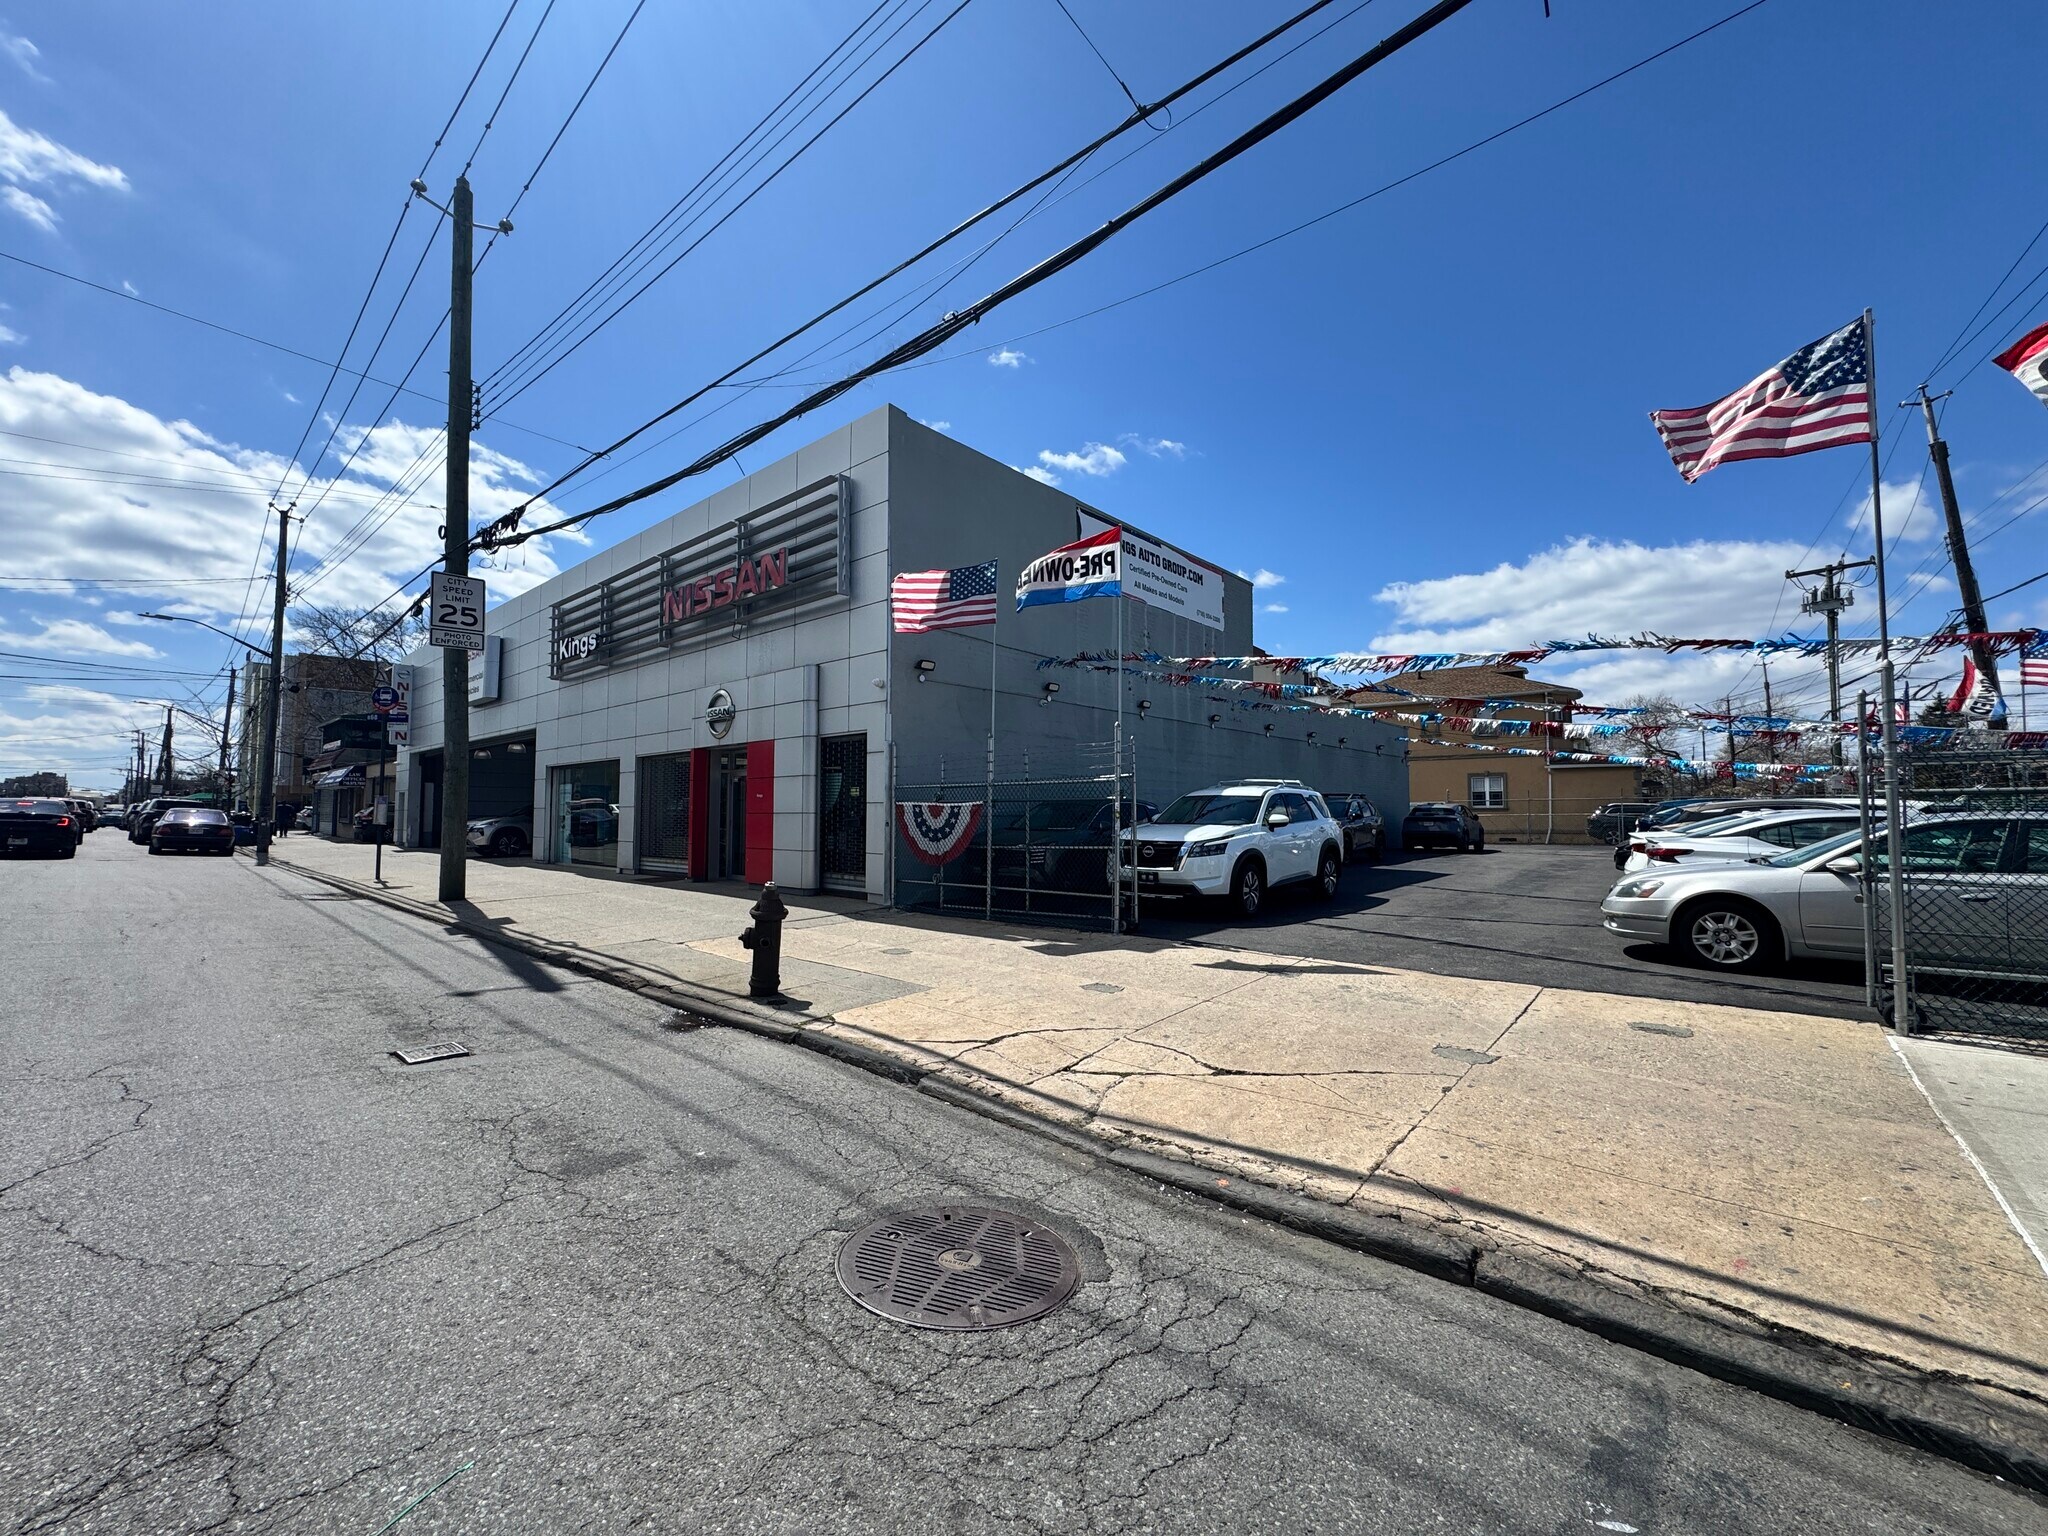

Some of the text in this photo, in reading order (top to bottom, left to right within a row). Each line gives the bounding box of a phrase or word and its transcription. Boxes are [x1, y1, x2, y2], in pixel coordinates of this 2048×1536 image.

[1129, 563, 1188, 593] Certified Pre-Owned Cars
[1138, 547, 1161, 567] AUTO
[1162, 558, 1203, 586] GROUP.COM
[442, 585, 473, 596] SPEED
[447, 577, 468, 587] CITY
[663, 547, 787, 625] NISSAN
[446, 594, 470, 604] LIMIT
[1142, 583, 1157, 595] Makes
[1158, 590, 1167, 599] and
[1168, 593, 1184, 606] Models
[438, 603, 478, 627] 25
[435, 638, 480, 648] ENFORCED
[444, 632, 472, 641] PHOTO
[560, 633, 597, 660] Kings
[395, 681, 410, 741] NISN
